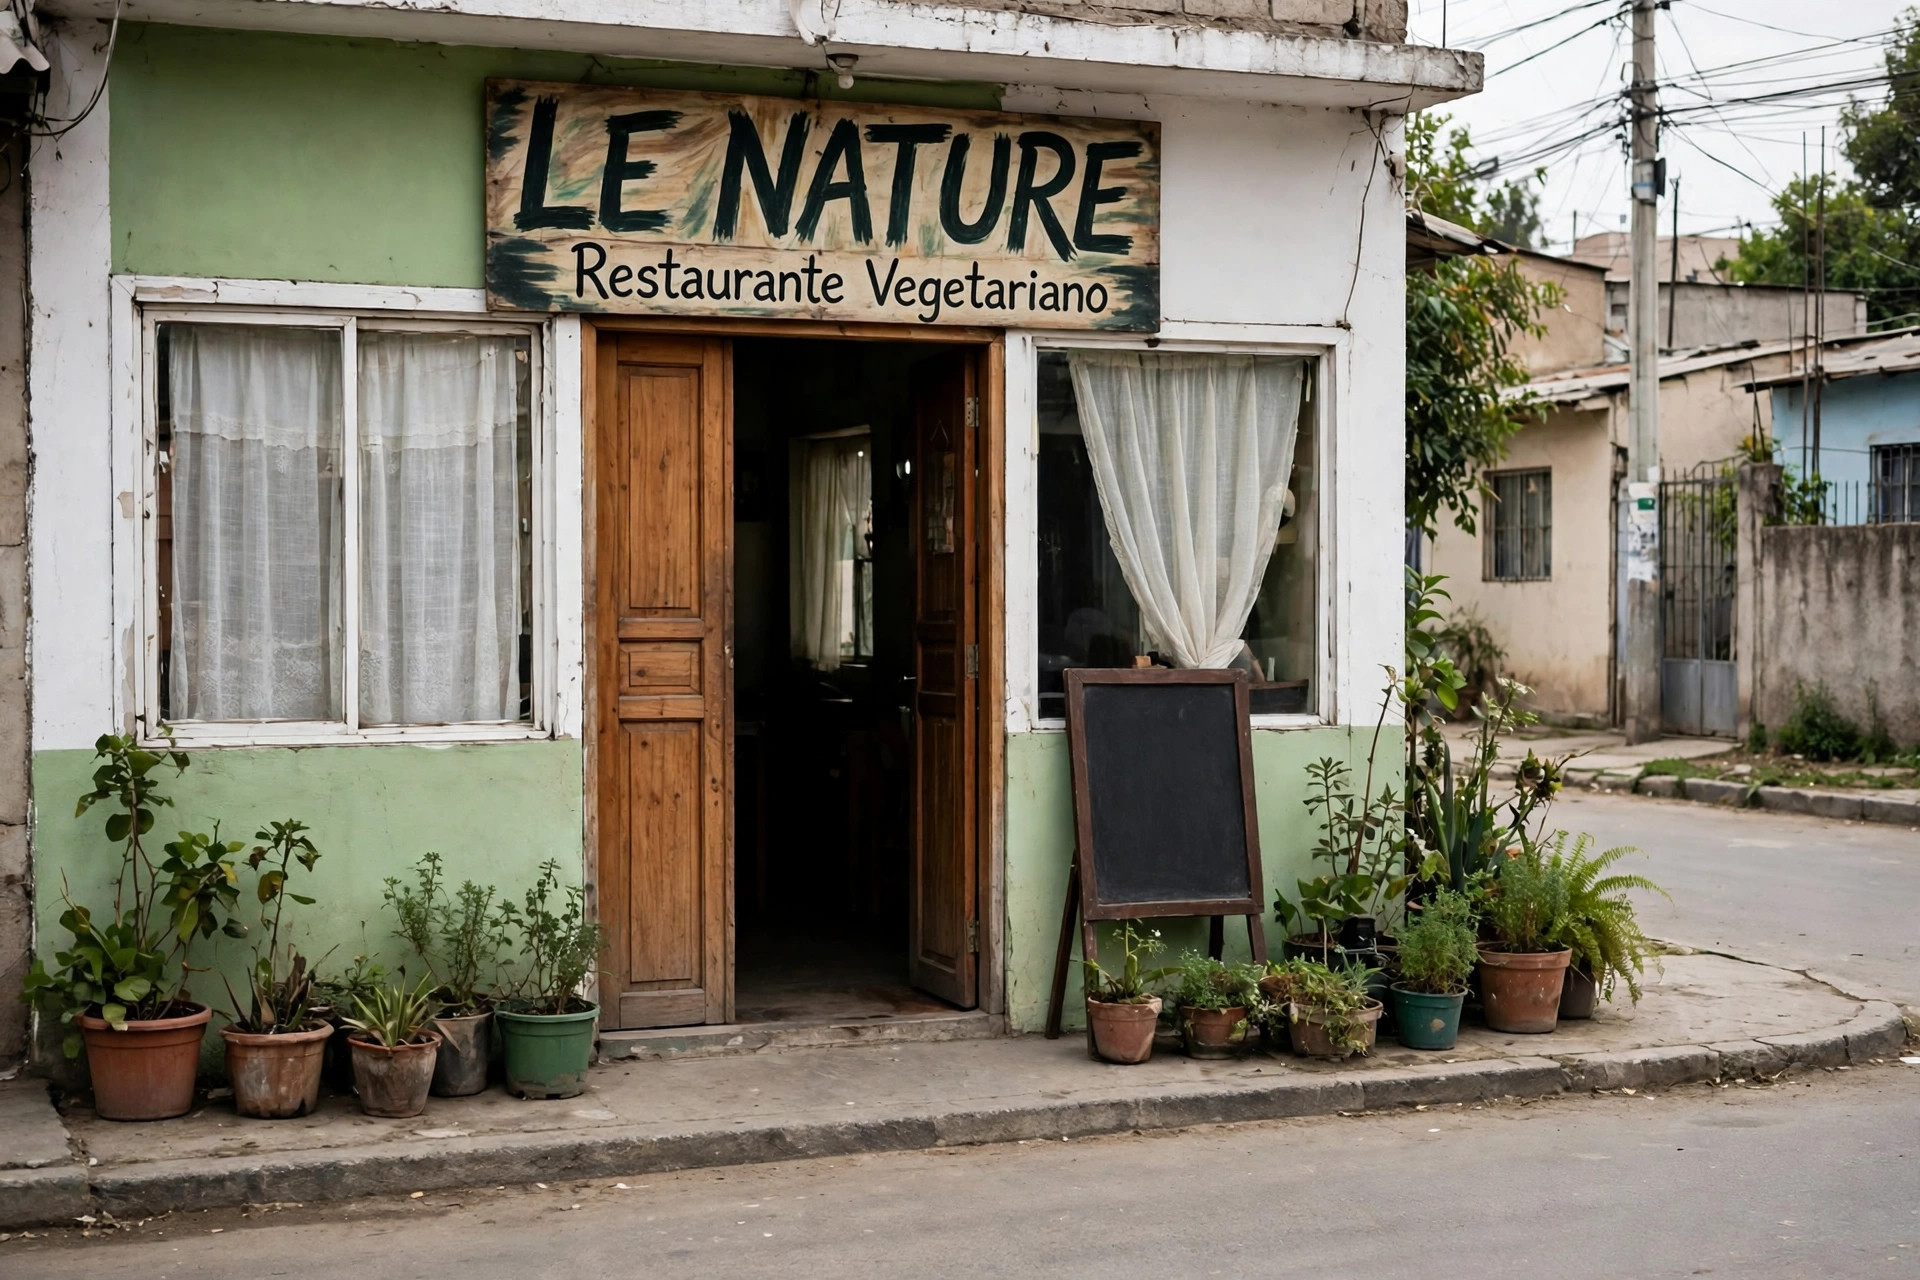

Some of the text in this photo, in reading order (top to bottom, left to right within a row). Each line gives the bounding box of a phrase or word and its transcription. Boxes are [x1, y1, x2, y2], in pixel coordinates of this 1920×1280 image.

[513, 97, 1143, 262] LE NATURE
[571, 241, 1109, 323] Restaurante Vegetariano
